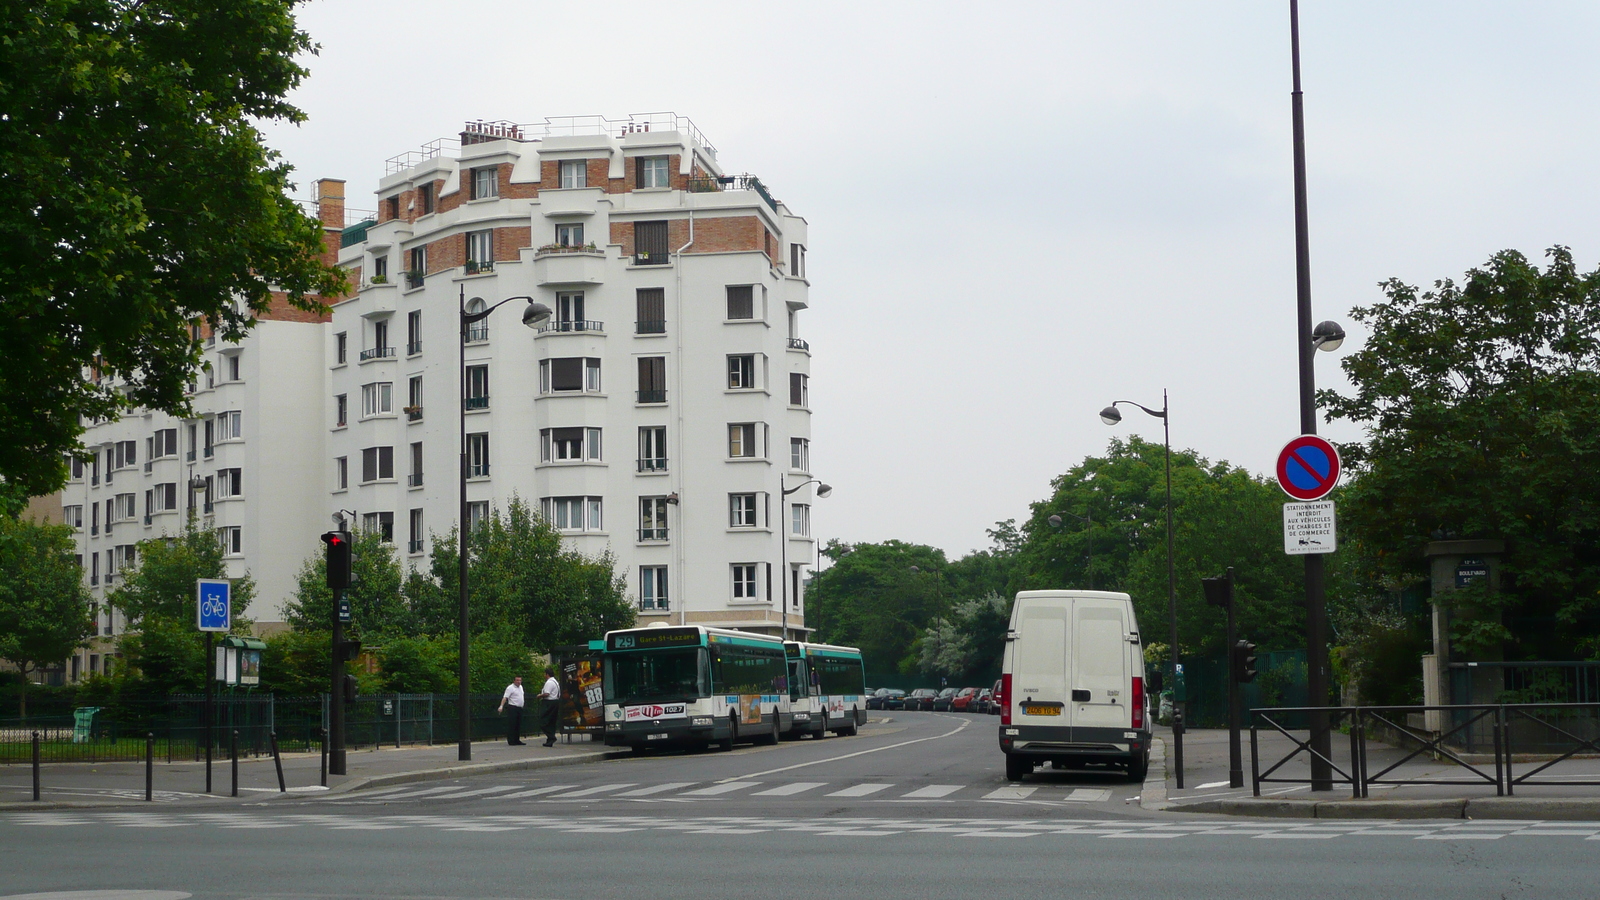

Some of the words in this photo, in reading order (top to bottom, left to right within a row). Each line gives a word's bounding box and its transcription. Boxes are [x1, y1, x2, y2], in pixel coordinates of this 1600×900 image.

[619, 636, 633, 648] 29
[639, 636, 657, 644] Gare
[659, 634, 695, 642] St-Lazare
[585, 687, 603, 704] 88
